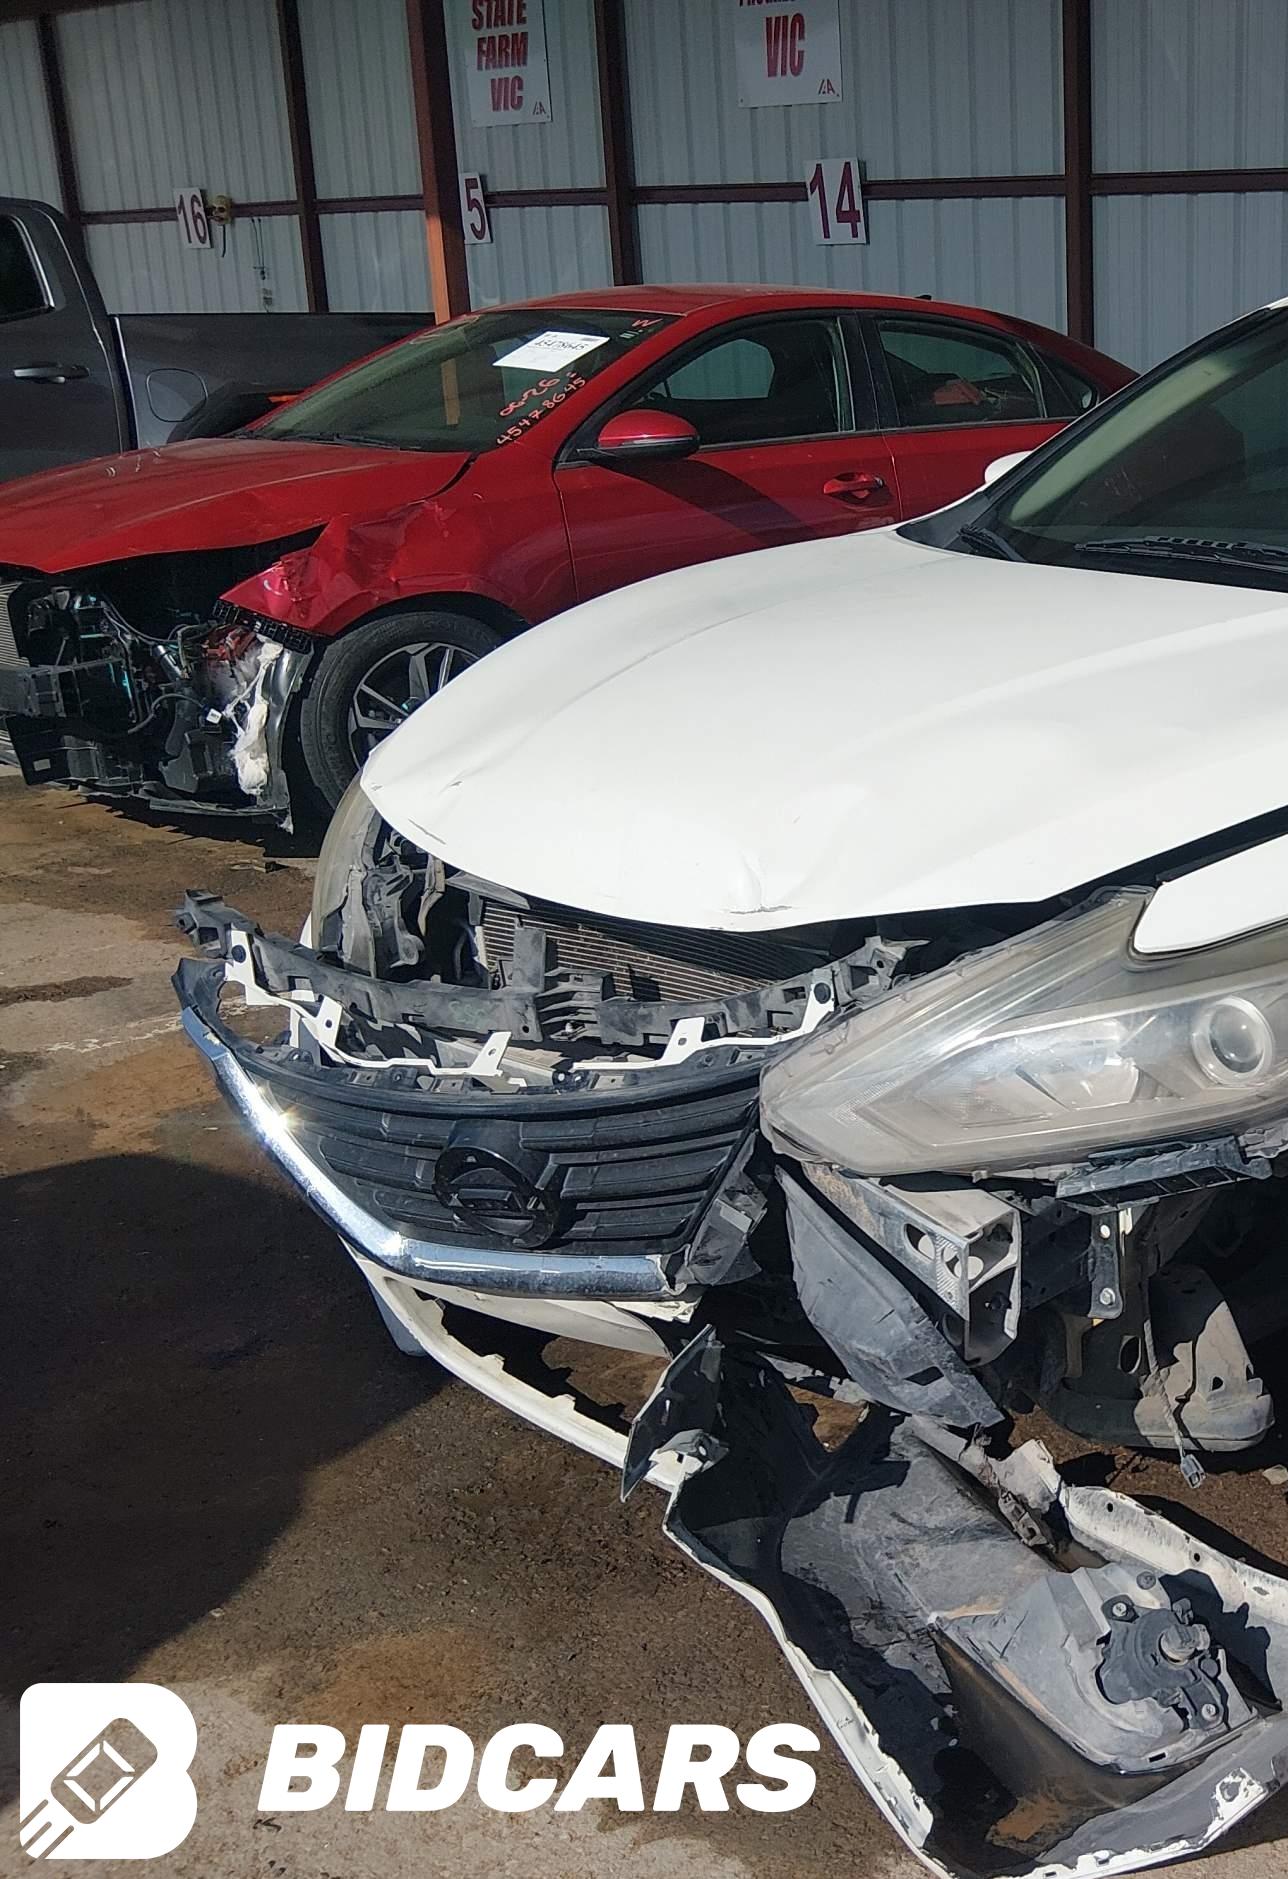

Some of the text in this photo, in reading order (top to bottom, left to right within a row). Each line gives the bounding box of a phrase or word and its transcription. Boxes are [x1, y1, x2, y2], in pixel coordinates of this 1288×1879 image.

[471, 0, 528, 30] STATE
[476, 32, 529, 71] FARM
[765, 13, 806, 78] VIC
[490, 75, 524, 112] VIC
[177, 194, 208, 245] 16
[464, 177, 486, 241] 5
[809, 161, 861, 239] 14
